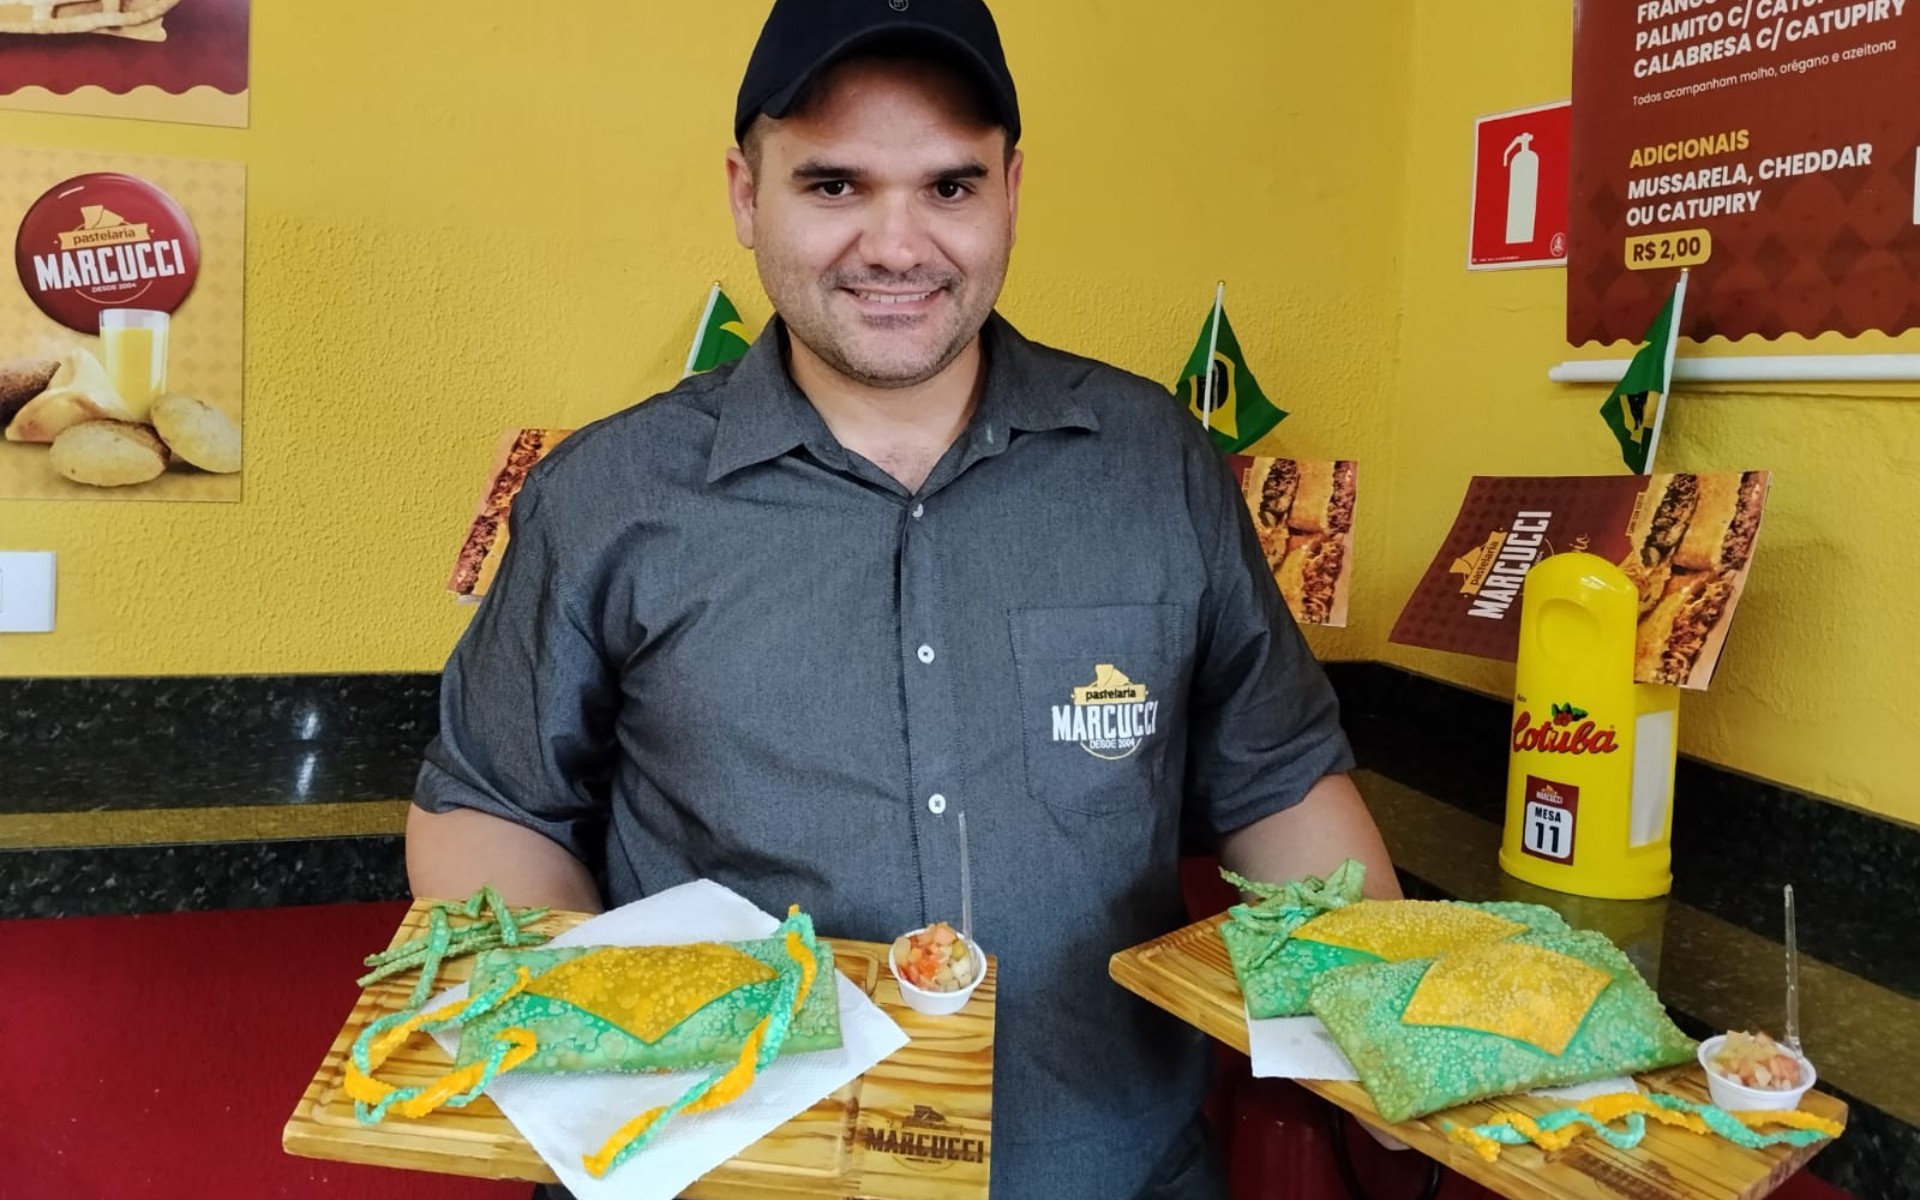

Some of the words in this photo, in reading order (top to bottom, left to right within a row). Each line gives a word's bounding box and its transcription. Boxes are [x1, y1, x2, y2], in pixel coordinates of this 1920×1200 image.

[1633, 32, 1752, 78] CALABRESA
[1756, 17, 1784, 51] C/
[1785, 0, 1907, 41] CATUPIRY
[1635, 11, 1724, 52] PALMITO
[1727, 0, 1754, 29] C/
[1632, 91, 1662, 106] Todos
[1663, 75, 1738, 97] acompanham
[1739, 66, 1778, 83] molho,
[1780, 55, 1830, 74] orégano
[1831, 52, 1840, 63] e
[1842, 40, 1897, 60] azeitona
[1629, 129, 1750, 169] ADICIONAIS
[1627, 162, 1754, 200] MUSSARELA,
[1758, 143, 1873, 181] CHEDDAR
[1626, 205, 1655, 227] OU
[1657, 190, 1762, 223] CATUPIRY
[73, 228, 136, 247] pastelaria
[1633, 240, 1657, 262] R$
[1660, 236, 1702, 261] 2,00
[33, 239, 186, 291] MARCUCCI
[1467, 511, 1553, 620] MARCUCCI
[1470, 541, 1500, 586] pastelaria
[1085, 688, 1136, 702] pastelaria
[1052, 700, 1158, 741] MARCUCCI
[1535, 806, 1562, 823] MESA
[1535, 821, 1560, 853] 11
[865, 1127, 984, 1164] MARCUCCI
